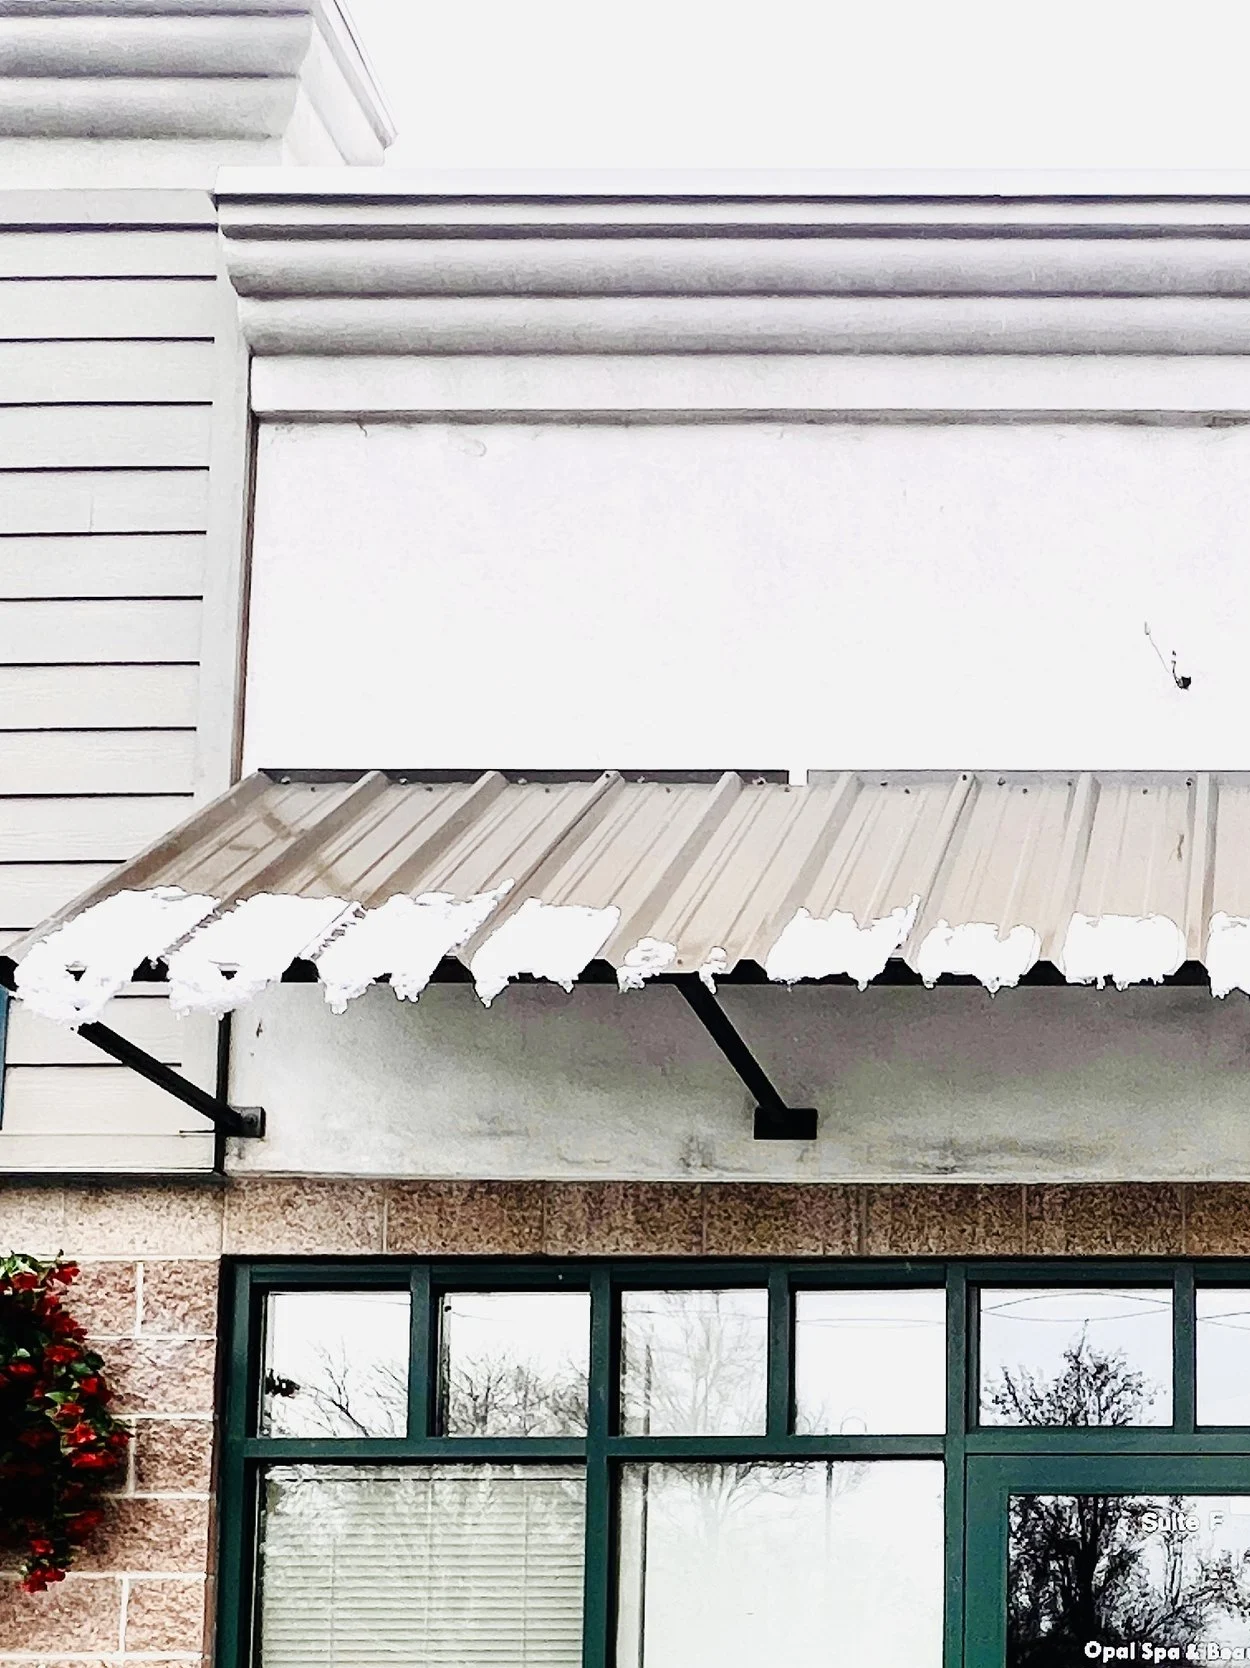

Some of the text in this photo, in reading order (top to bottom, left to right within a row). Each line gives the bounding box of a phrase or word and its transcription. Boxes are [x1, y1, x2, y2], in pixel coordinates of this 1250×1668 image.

[1141, 1511, 1200, 1533] Suite
[1084, 1641, 1136, 1663] Opal
[1141, 1643, 1180, 1664] Spa
[1185, 1644, 1200, 1660] &
